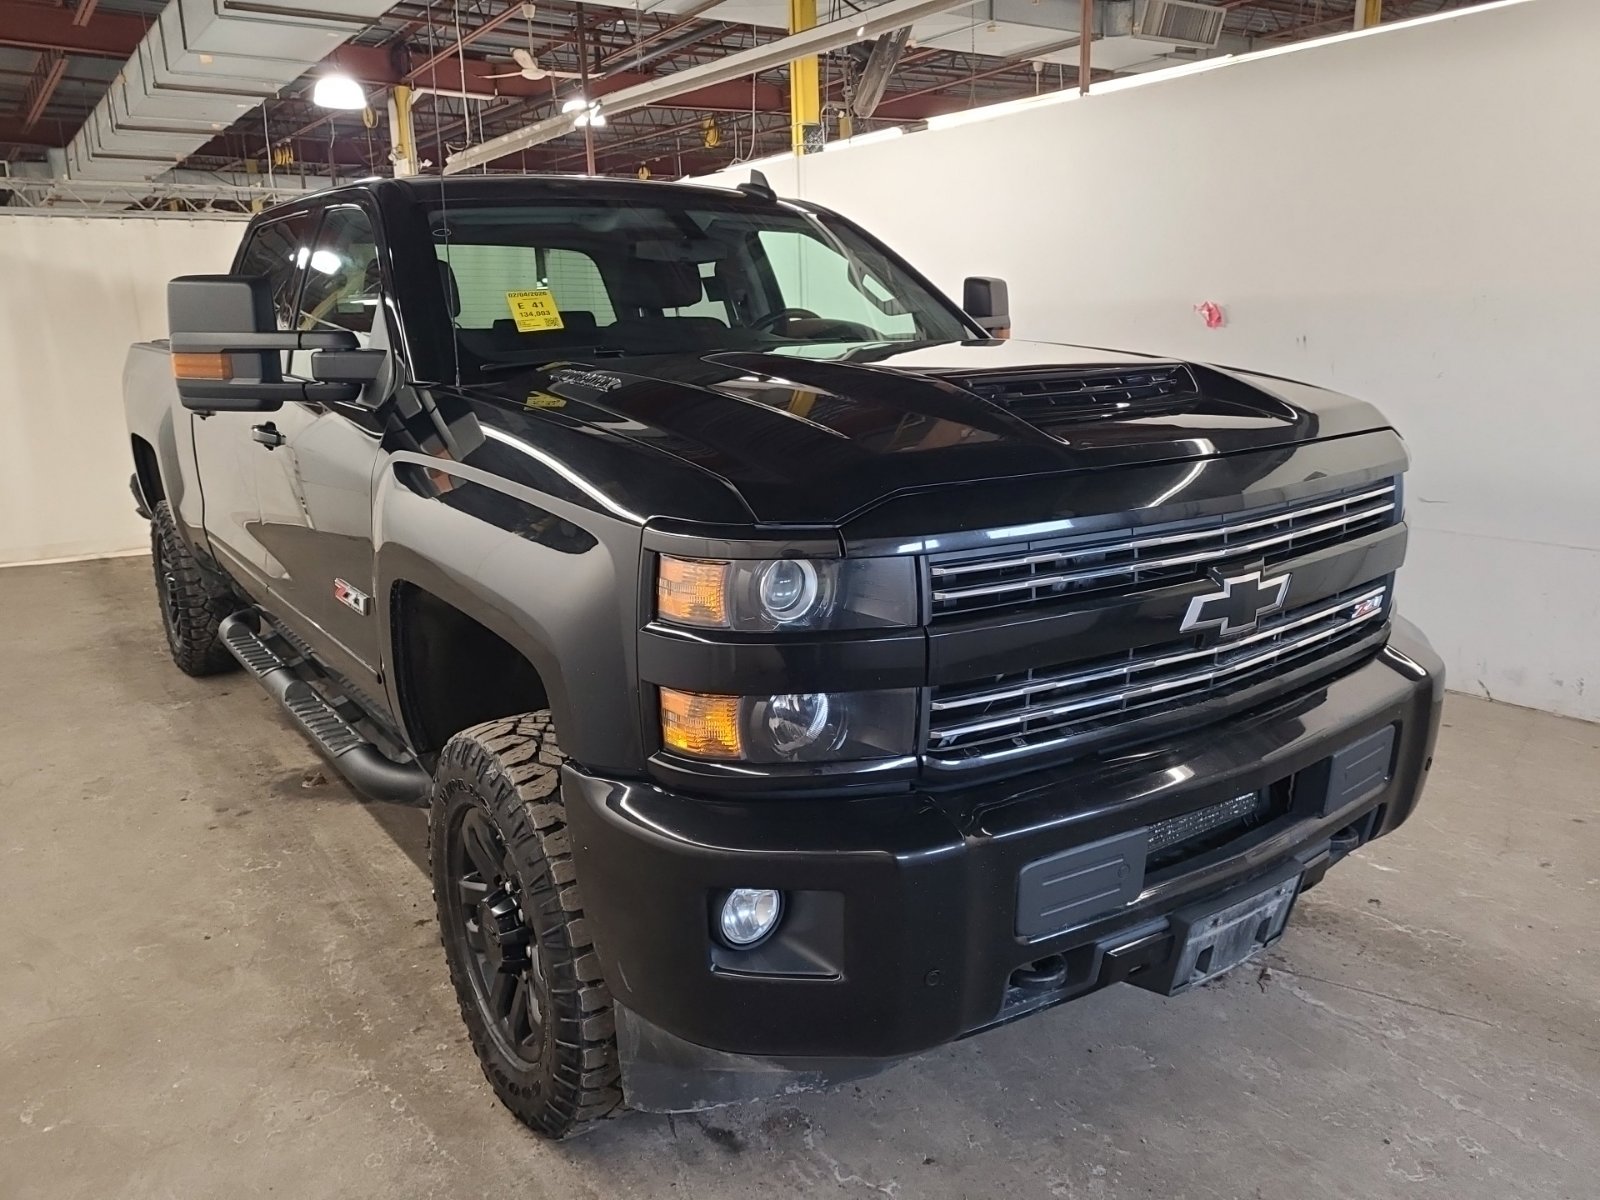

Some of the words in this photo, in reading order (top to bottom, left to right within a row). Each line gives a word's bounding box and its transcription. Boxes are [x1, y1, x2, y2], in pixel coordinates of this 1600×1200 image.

[517, 302, 525, 310] E
[334, 577, 369, 616] Z71
[1351, 594, 1384, 619] Z71
